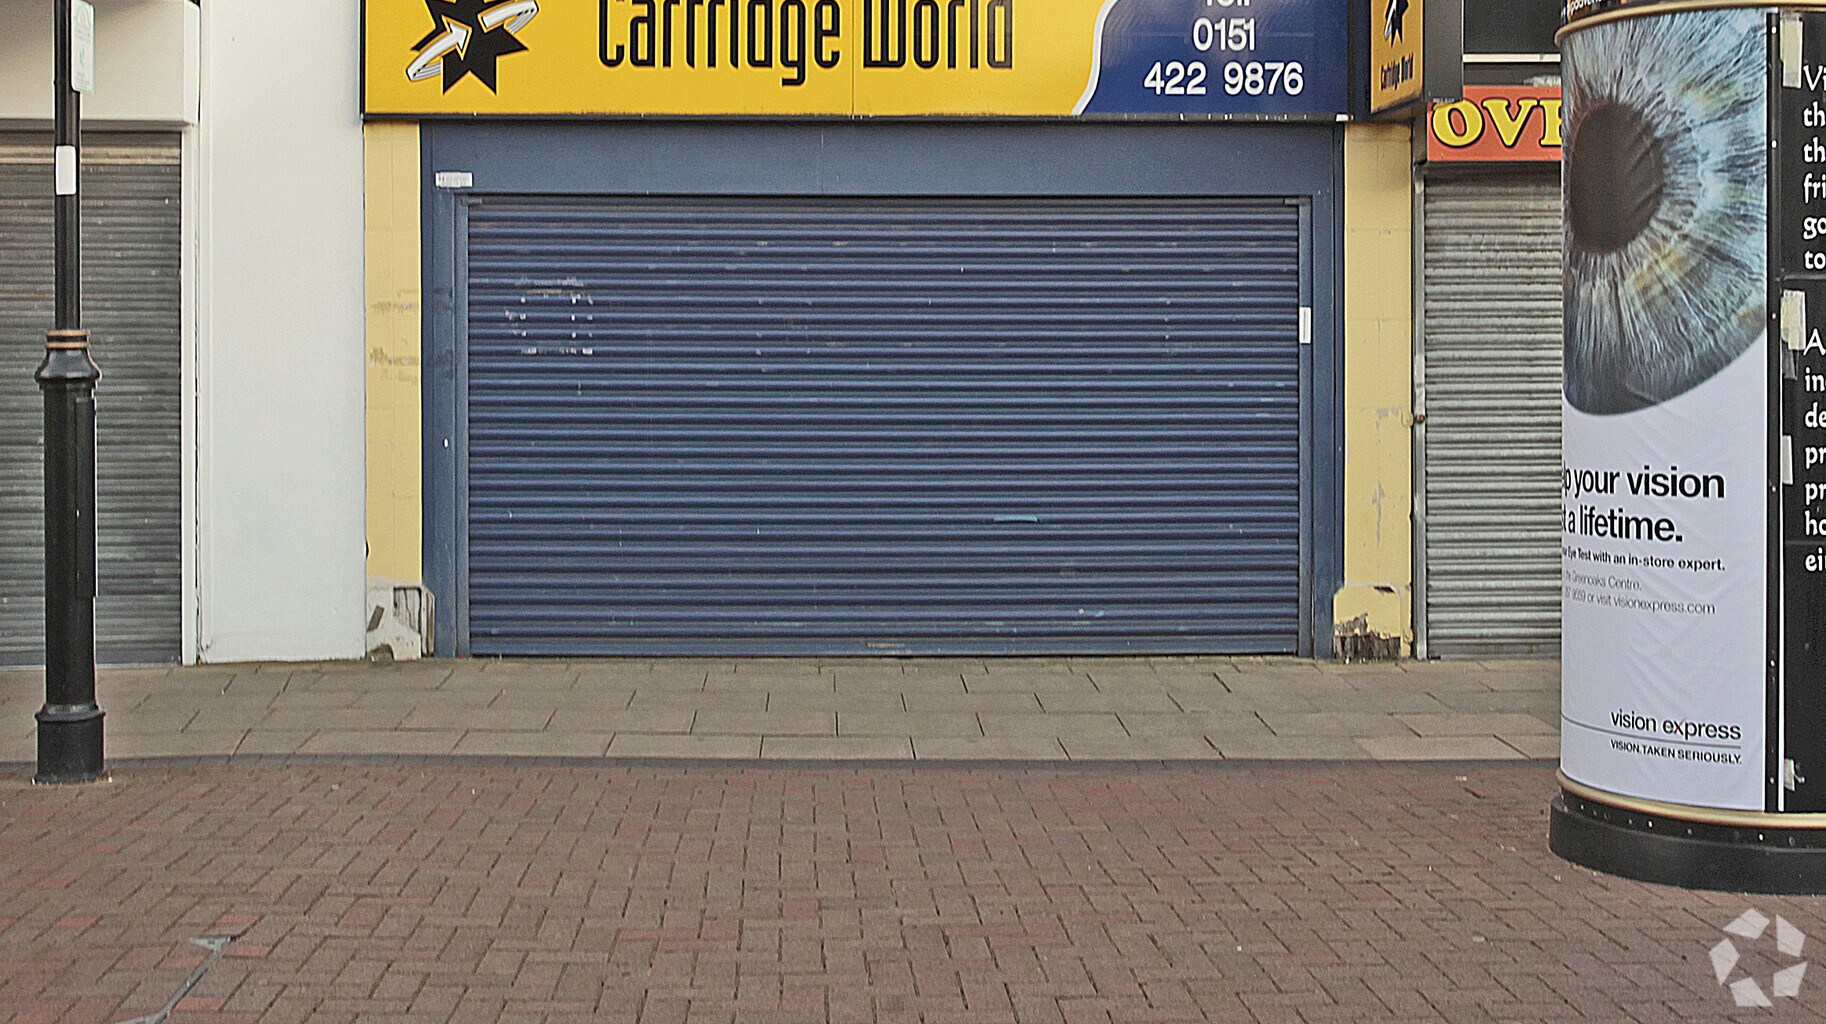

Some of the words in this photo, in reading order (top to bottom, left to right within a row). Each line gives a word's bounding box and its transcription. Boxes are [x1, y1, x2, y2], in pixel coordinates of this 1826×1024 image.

[1192, 18, 1256, 51] 0151
[1143, 62, 1207, 95] 422
[1223, 62, 1304, 95] 9876
[1805, 367, 1826, 393] in
[1574, 469, 1620, 499] your
[1627, 465, 1725, 498] vision
[1579, 504, 1683, 542] lifetime.
[1592, 549, 1611, 564] with
[1613, 555, 1626, 564] an
[1628, 553, 1675, 569] in-store
[1678, 558, 1726, 573] expert.
[1613, 594, 1716, 614] visionexpress.com
[1611, 708, 1657, 732] vision
[1663, 716, 1742, 741] express
[1643, 744, 1676, 759] TAKEN
